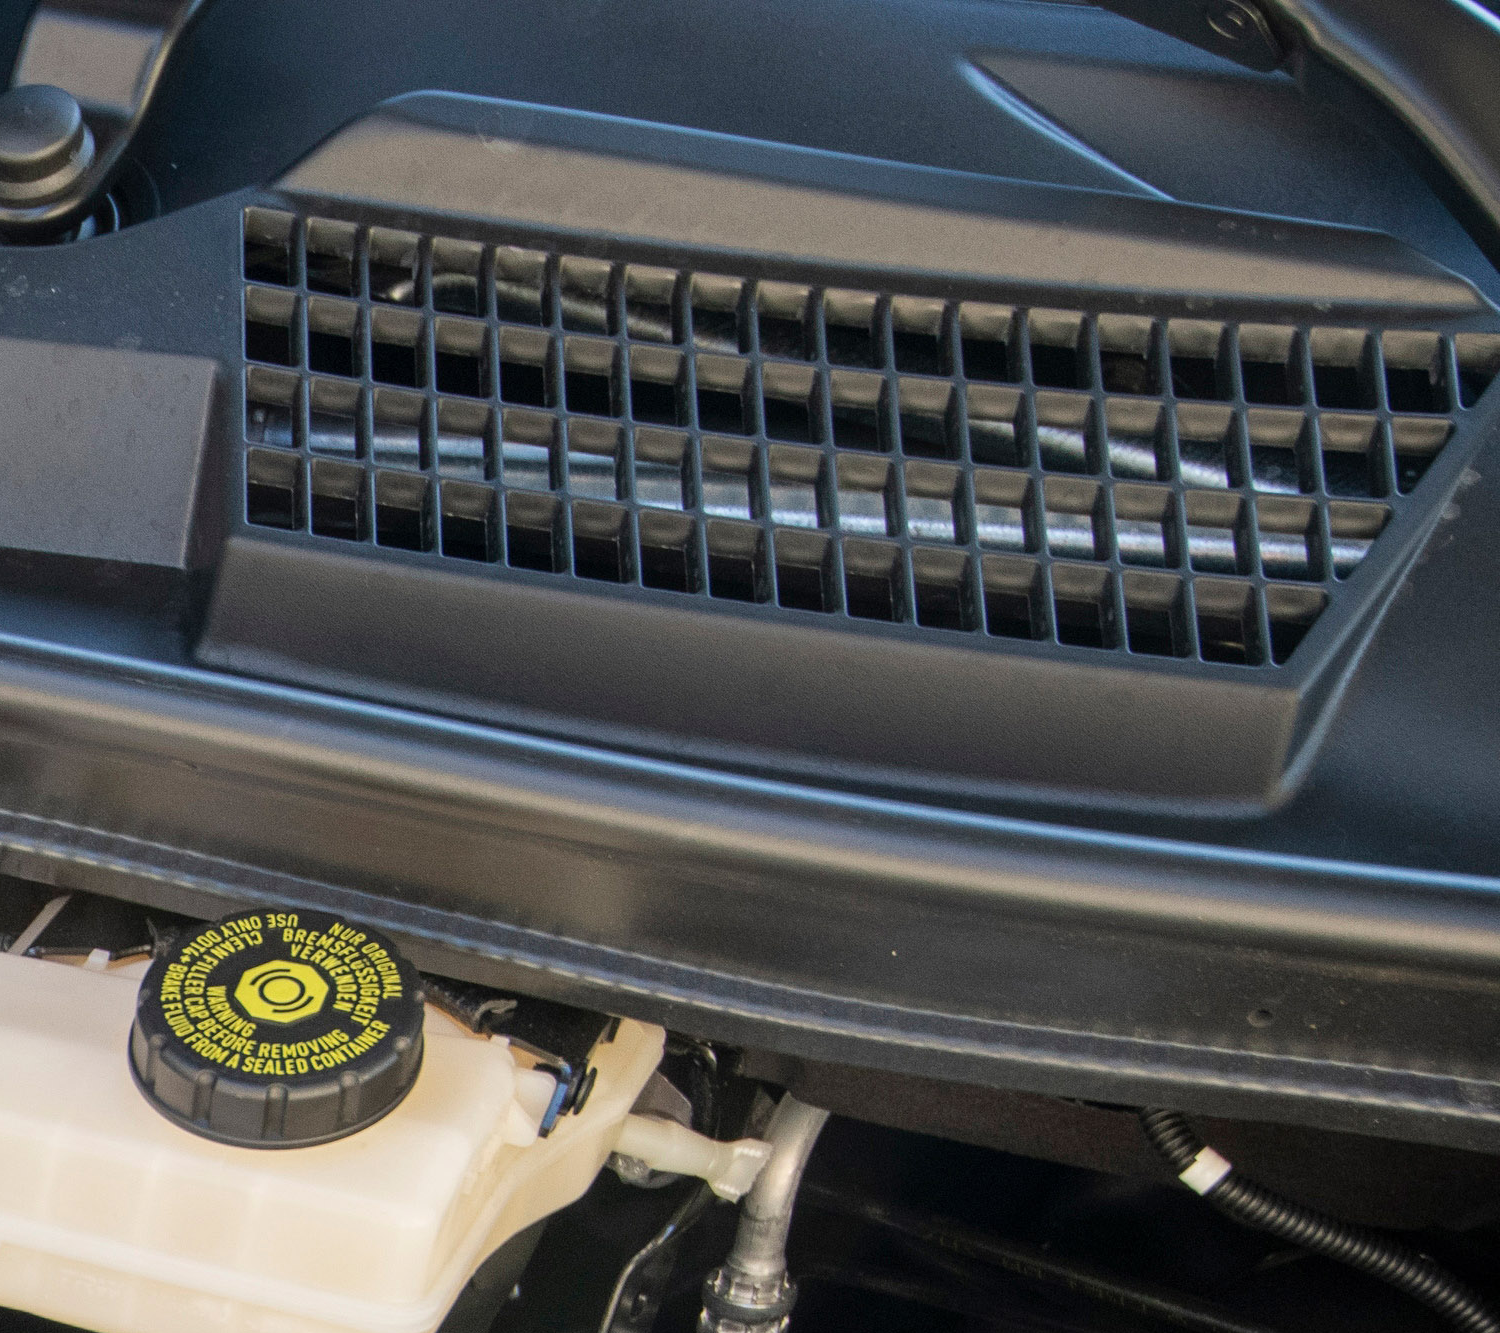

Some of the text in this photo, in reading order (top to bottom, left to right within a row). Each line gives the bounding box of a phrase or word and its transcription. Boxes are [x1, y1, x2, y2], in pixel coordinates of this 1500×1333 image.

[160, 913, 391, 1076] USE ONLY DOT4+ BRAKE FLUID FROM A SEALED CONTAINER
[184, 931, 350, 1059] CLEAN FILLER CAP BEFORE REMOVING
[282, 928, 381, 1026] BREMSFLÜSSIGKEIT
[291, 943, 358, 1012] VERWENDEN
[328, 922, 403, 1000] NUR ORIGINAL
[206, 985, 257, 1038] WARNING
